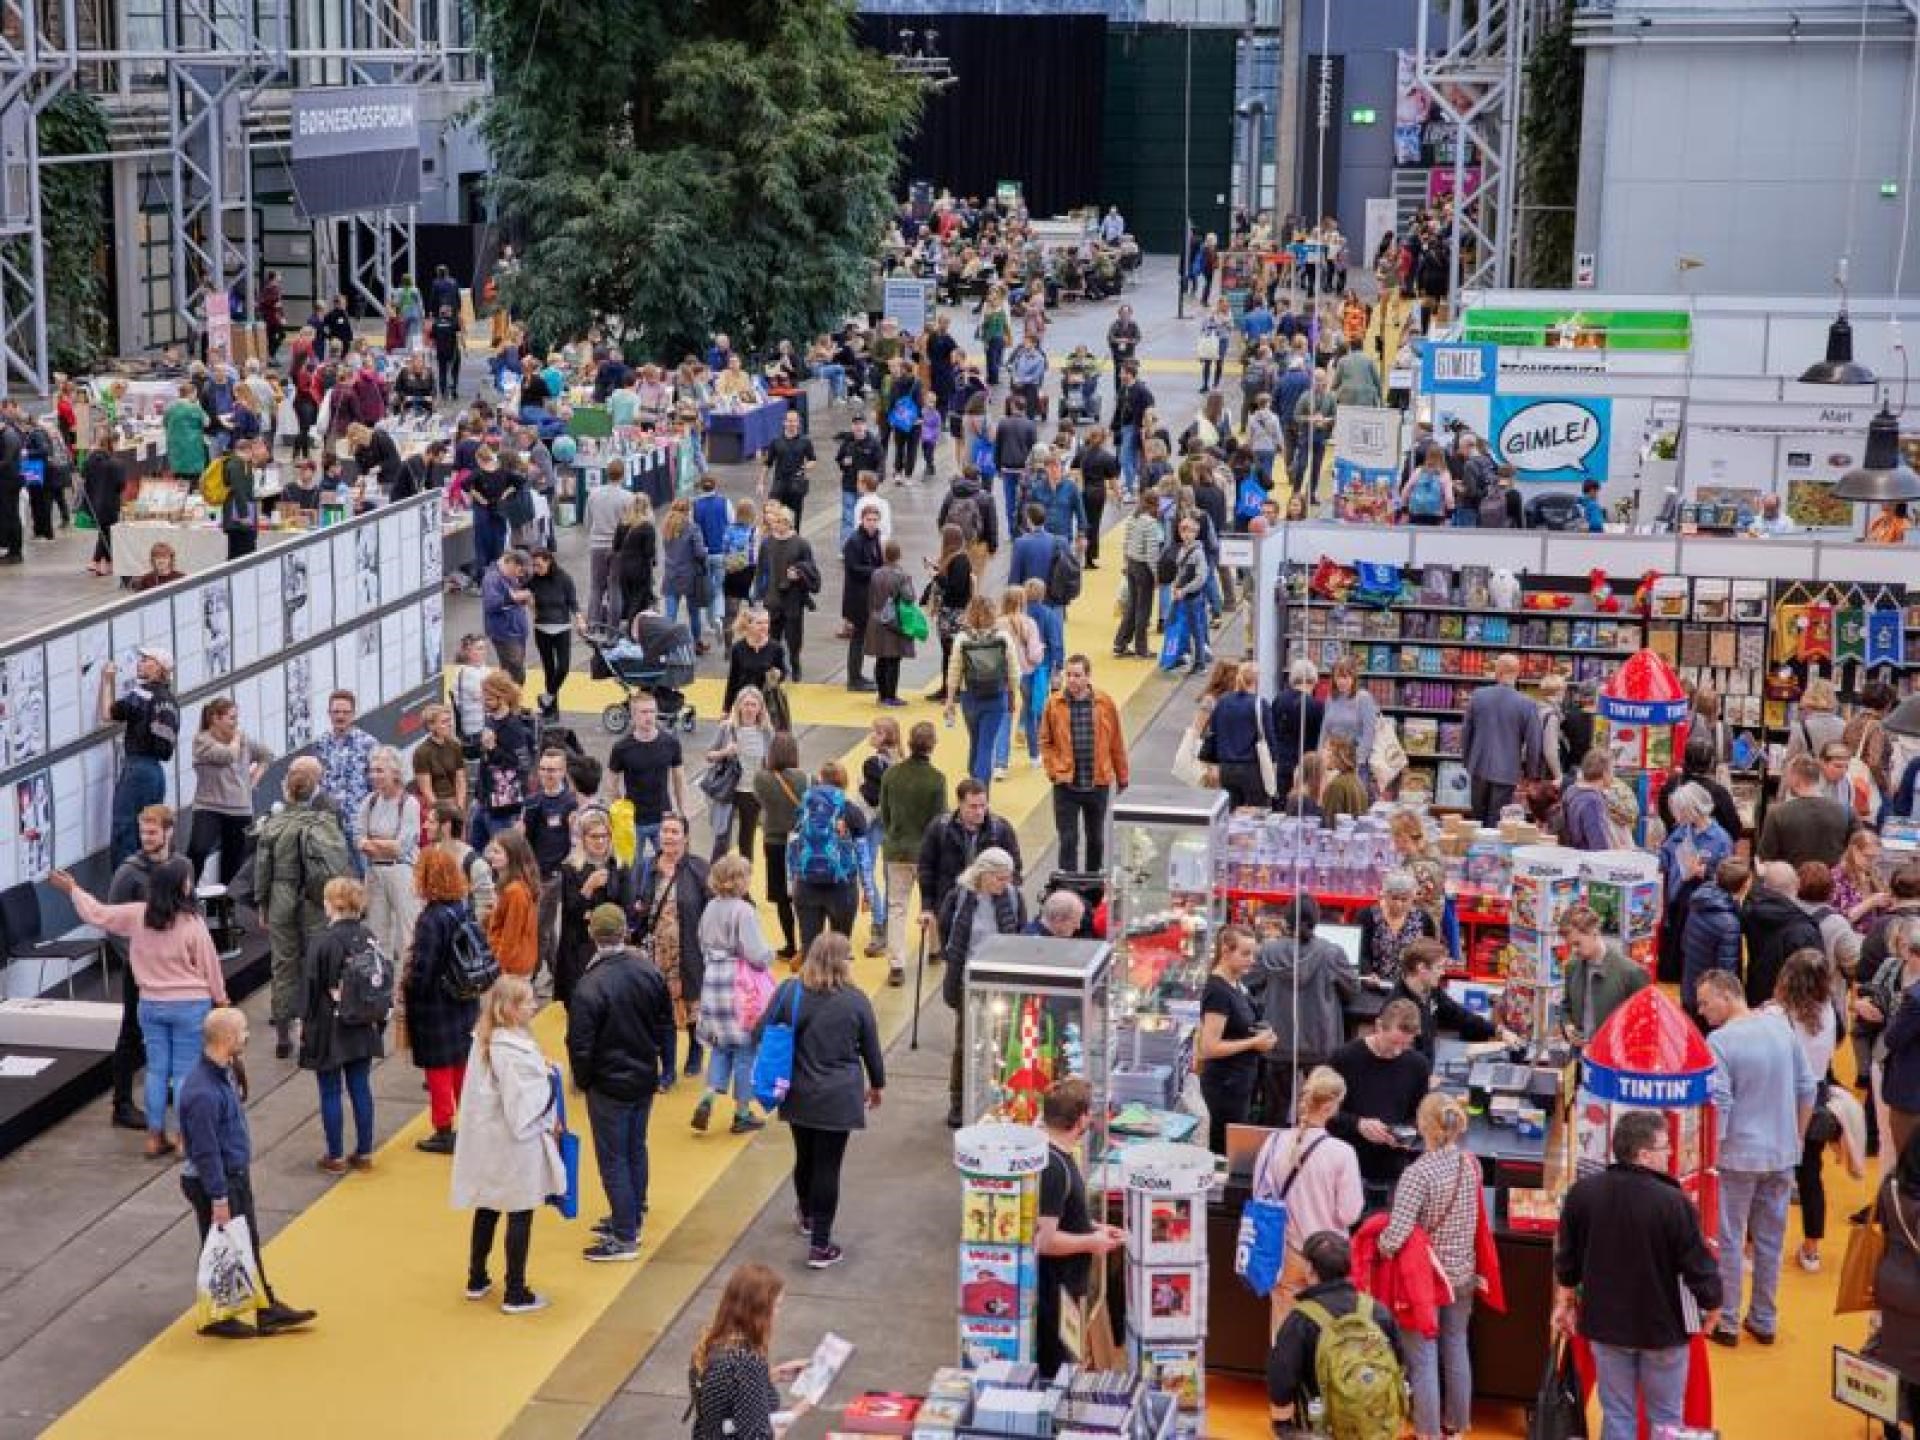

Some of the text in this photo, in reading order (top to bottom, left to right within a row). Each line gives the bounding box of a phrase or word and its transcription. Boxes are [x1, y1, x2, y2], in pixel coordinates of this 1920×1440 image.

[300, 104, 414, 135] BØRNEBOGSFORUM
[1507, 418, 1590, 453] GIMLE!
[1609, 703, 1651, 718] TINTIN
[1619, 1079, 1688, 1099] TINTIN
